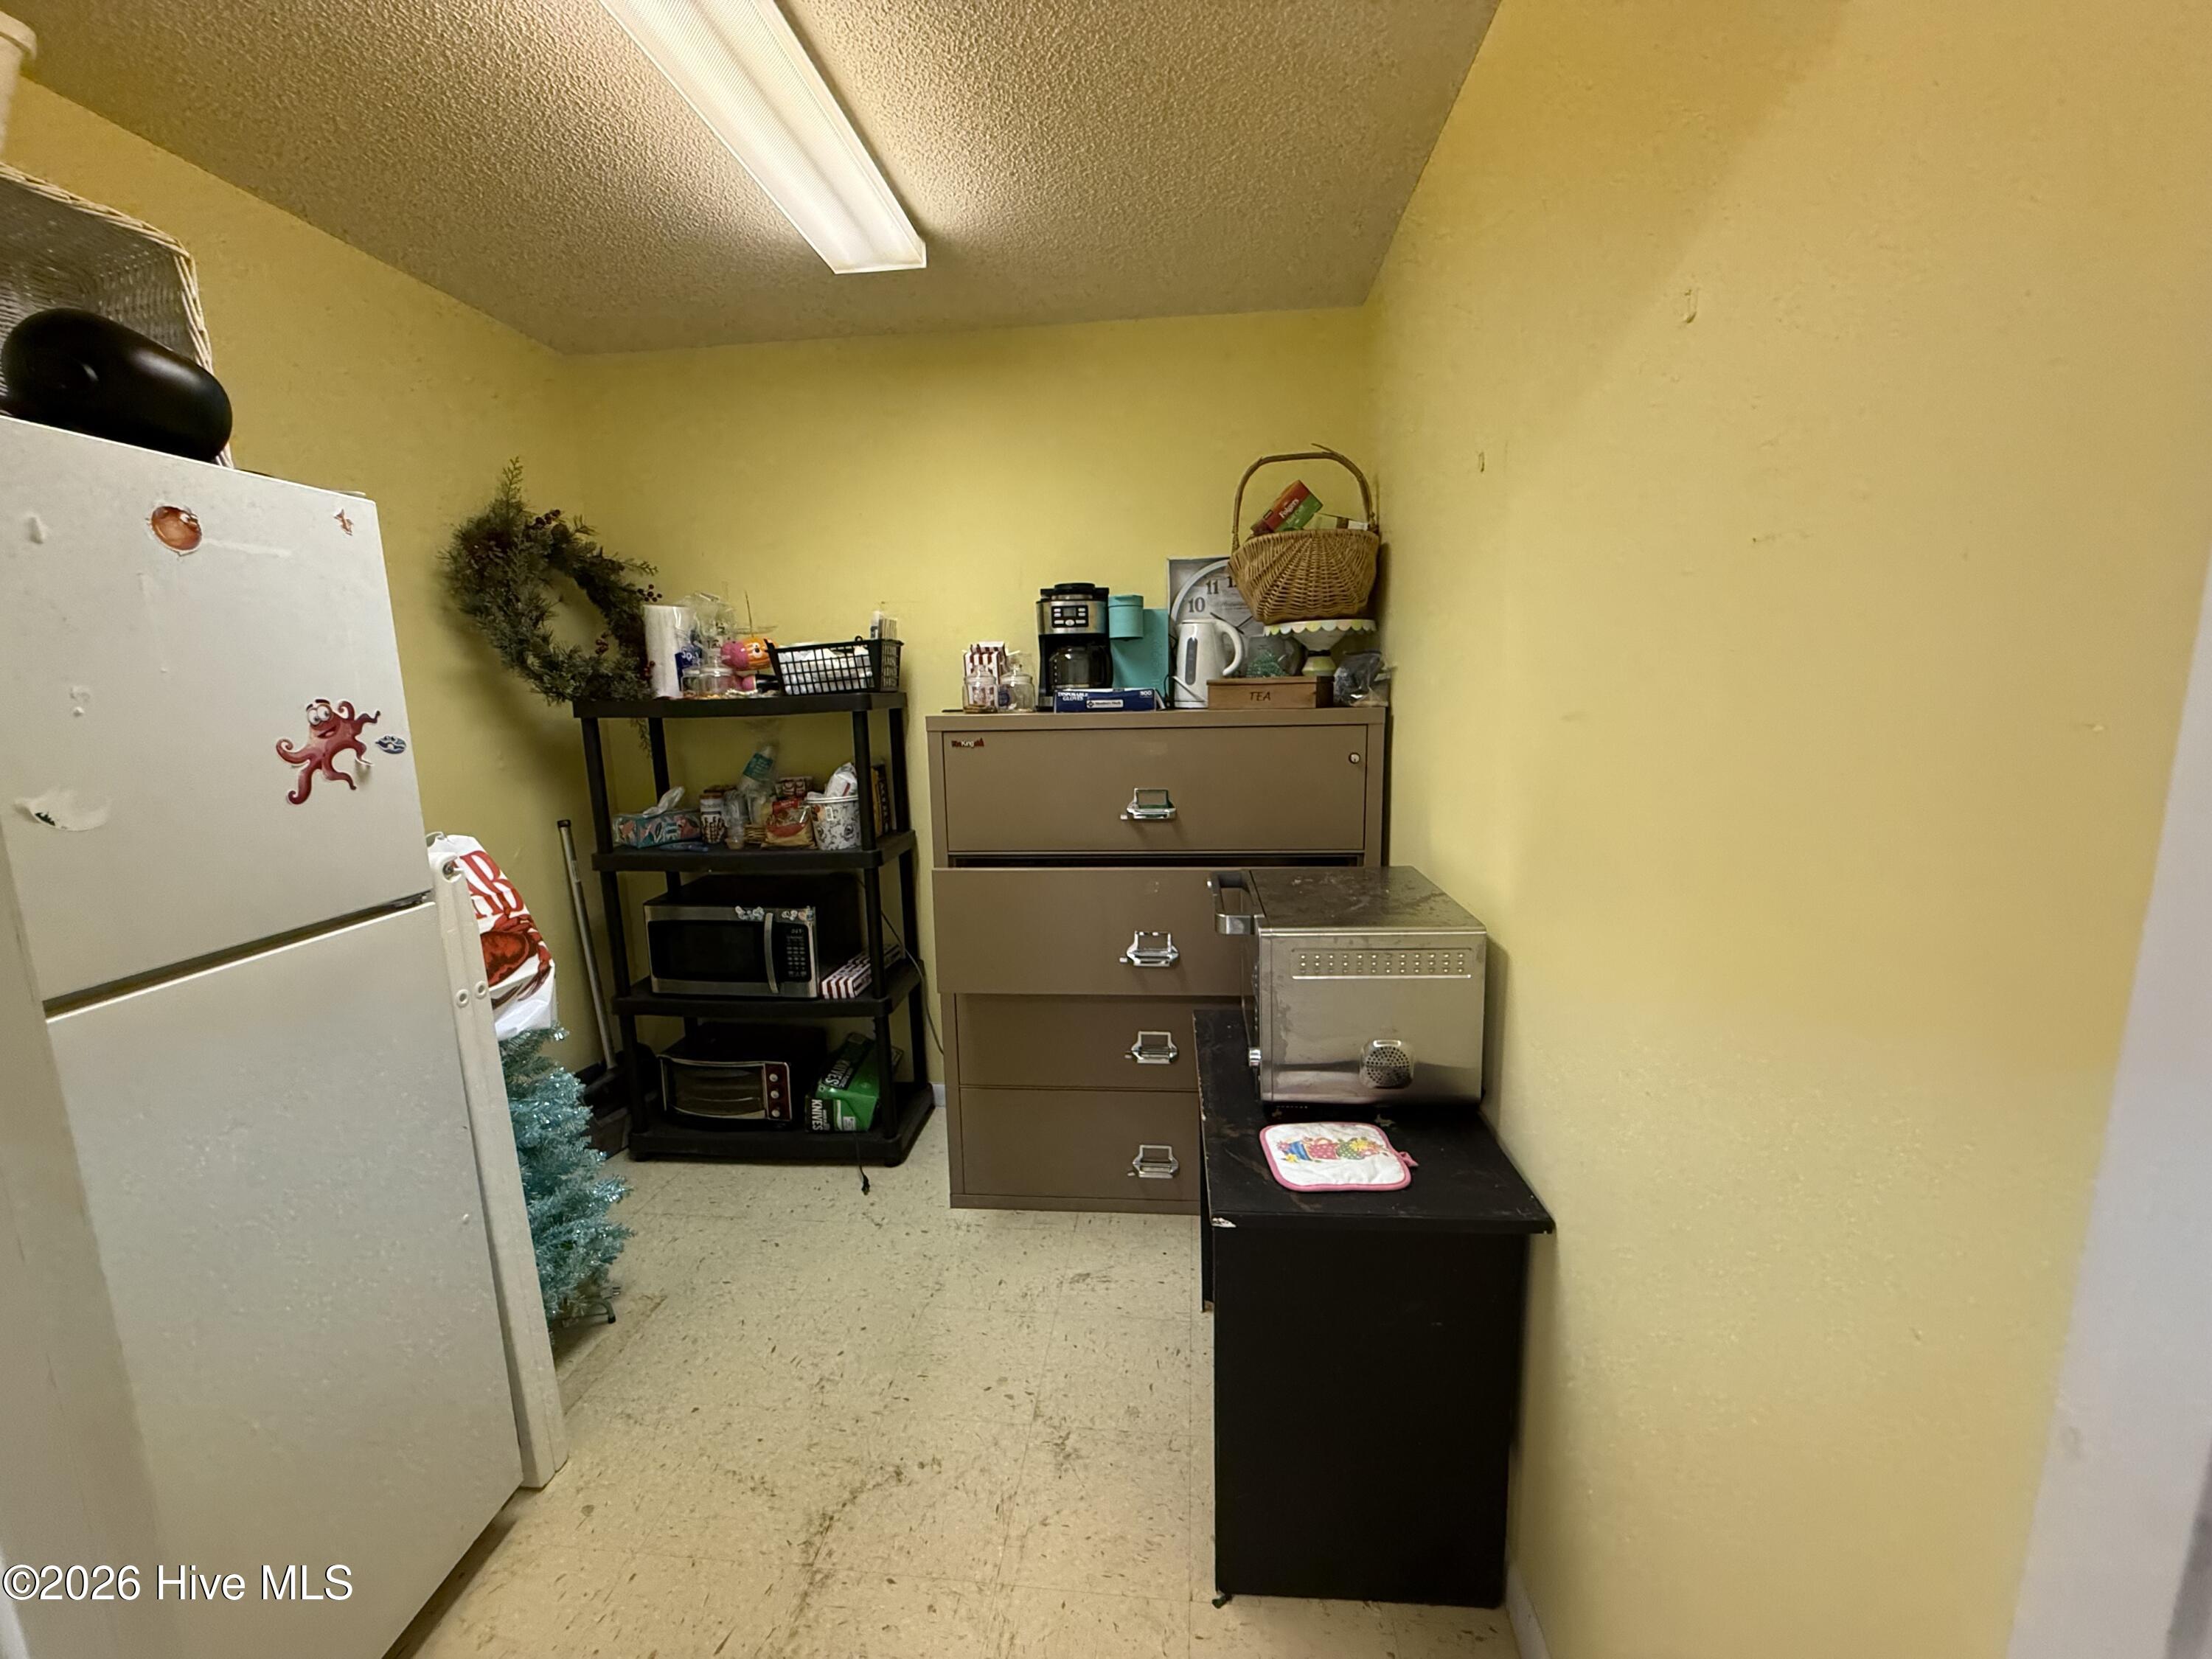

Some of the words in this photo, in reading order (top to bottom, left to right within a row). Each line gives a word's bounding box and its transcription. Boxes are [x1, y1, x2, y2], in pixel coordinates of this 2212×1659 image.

[1206, 580, 1219, 595] 11
[1189, 597, 1206, 613] 10
[1250, 691, 1271, 701] TEA
[812, 1099, 823, 1130] KNIVES
